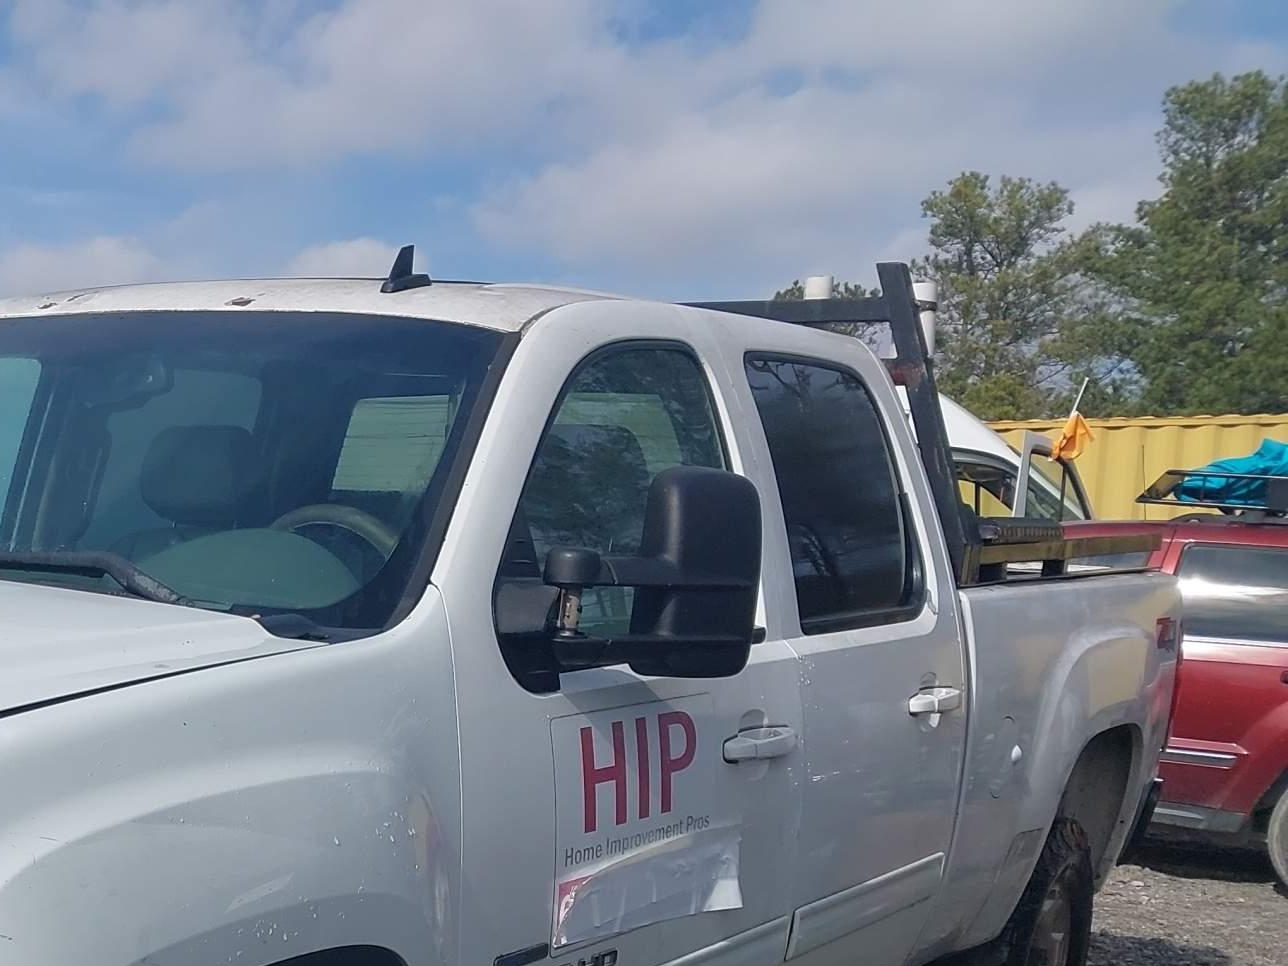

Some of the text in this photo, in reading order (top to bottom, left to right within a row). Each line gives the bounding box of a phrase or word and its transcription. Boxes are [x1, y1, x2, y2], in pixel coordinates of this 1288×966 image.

[579, 710, 697, 834] HIP
[564, 815, 711, 868] Home Improvement Pros
